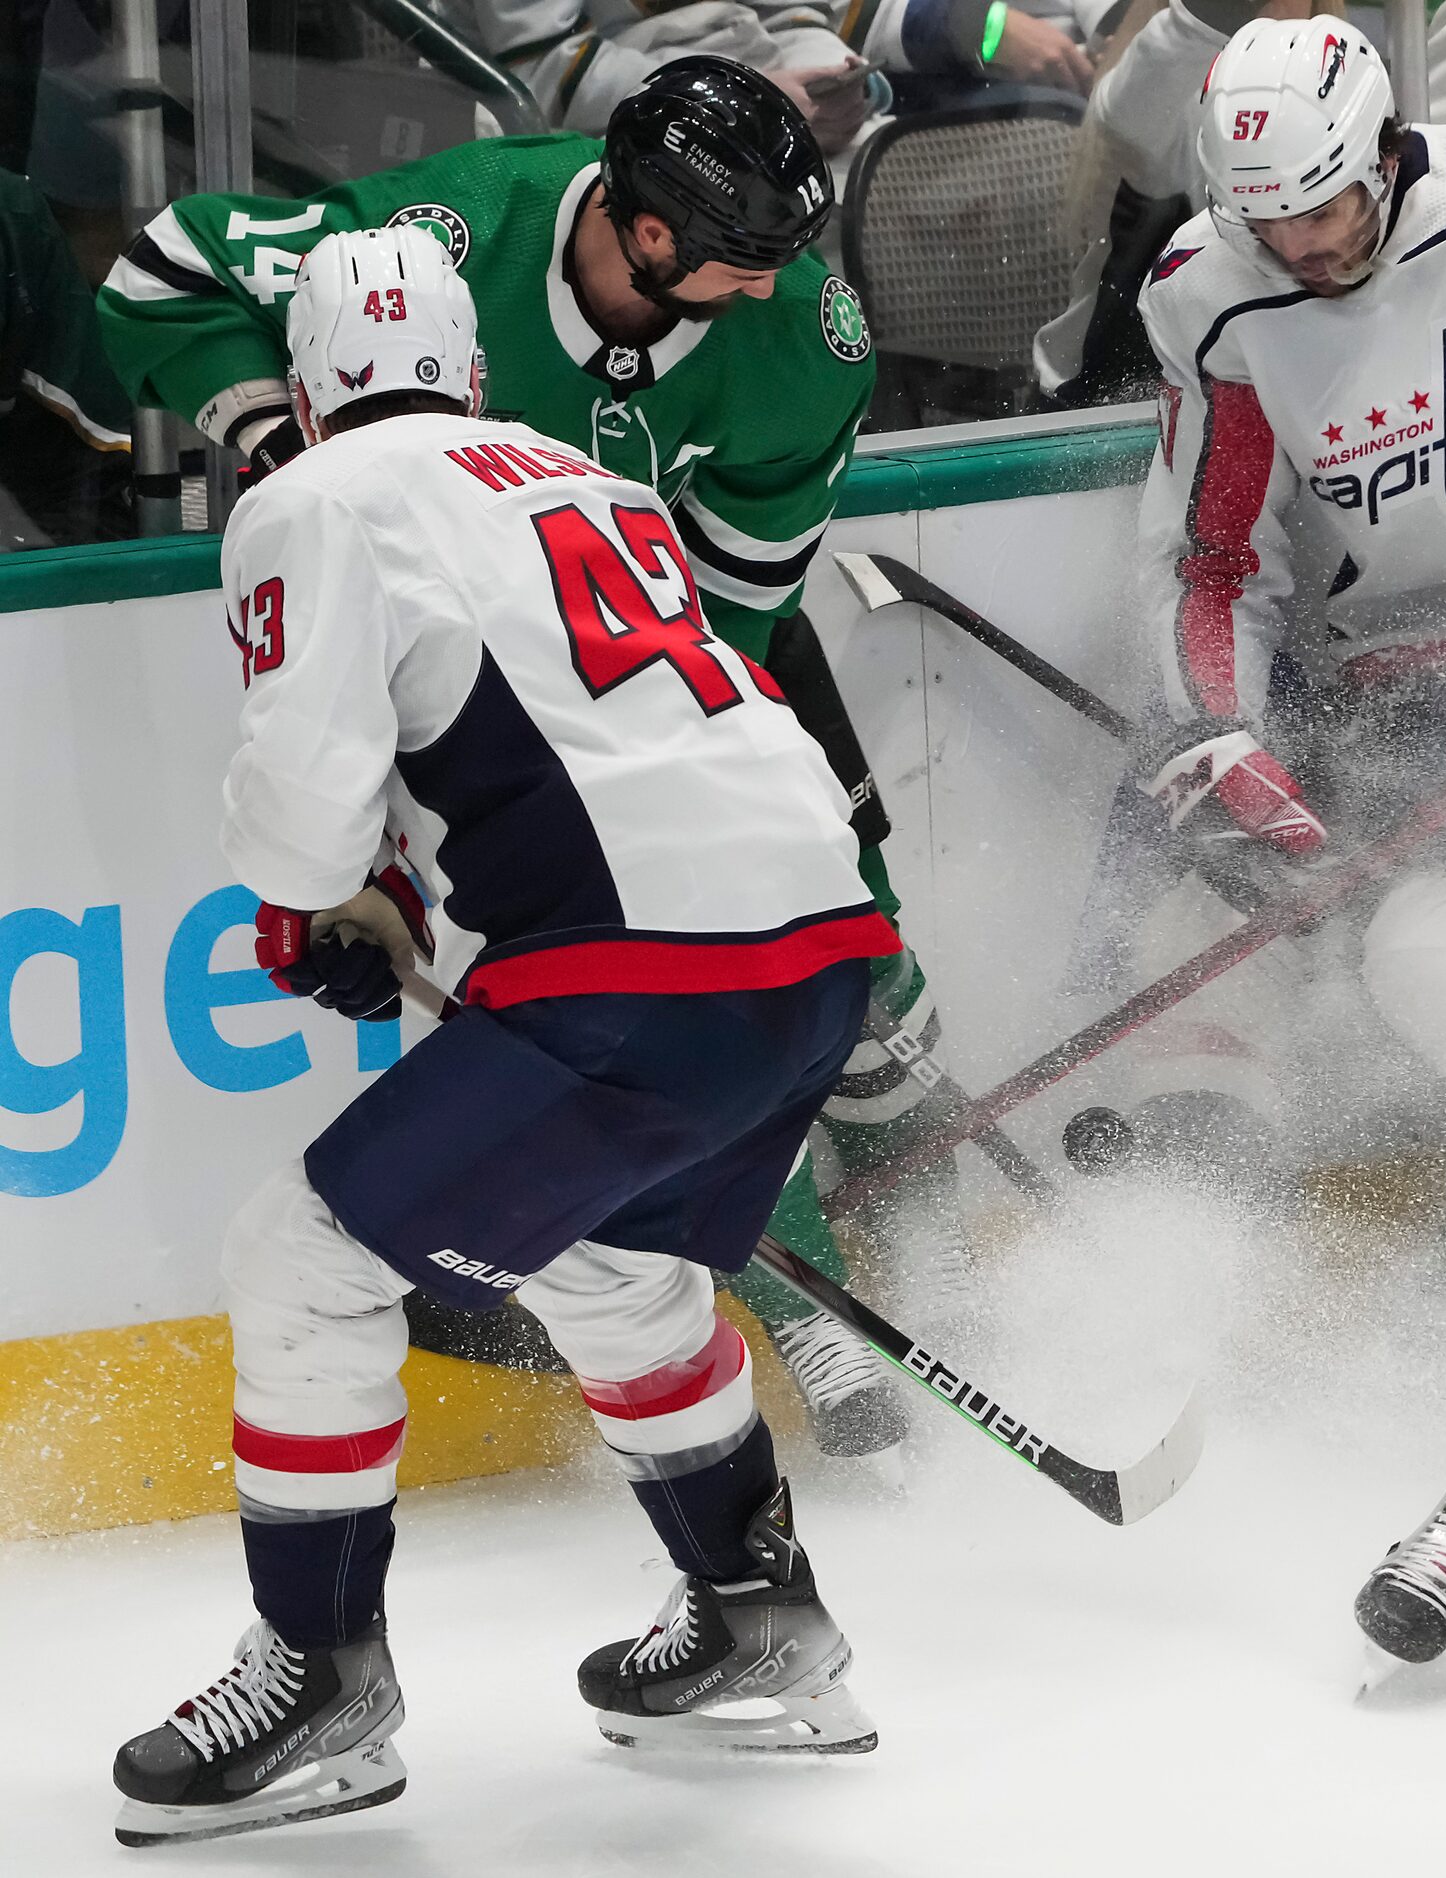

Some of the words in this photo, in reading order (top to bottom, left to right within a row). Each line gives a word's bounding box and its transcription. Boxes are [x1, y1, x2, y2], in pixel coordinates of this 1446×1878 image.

[1233, 111, 1269, 140] 57
[684, 152, 736, 196] TRANSFER
[690, 143, 732, 179] ENERGY
[798, 175, 825, 215] 14
[1232, 183, 1281, 193] CCM
[226, 204, 303, 305] 14
[363, 288, 407, 322] 43
[613, 357, 633, 372] NHL
[1313, 417, 1434, 470] WASHINGTON
[1271, 827, 1309, 839] CCM
[901, 1342, 1052, 1465] BAUER
[675, 1669, 724, 1706] BAUER
[255, 1725, 310, 1781] BAUER
